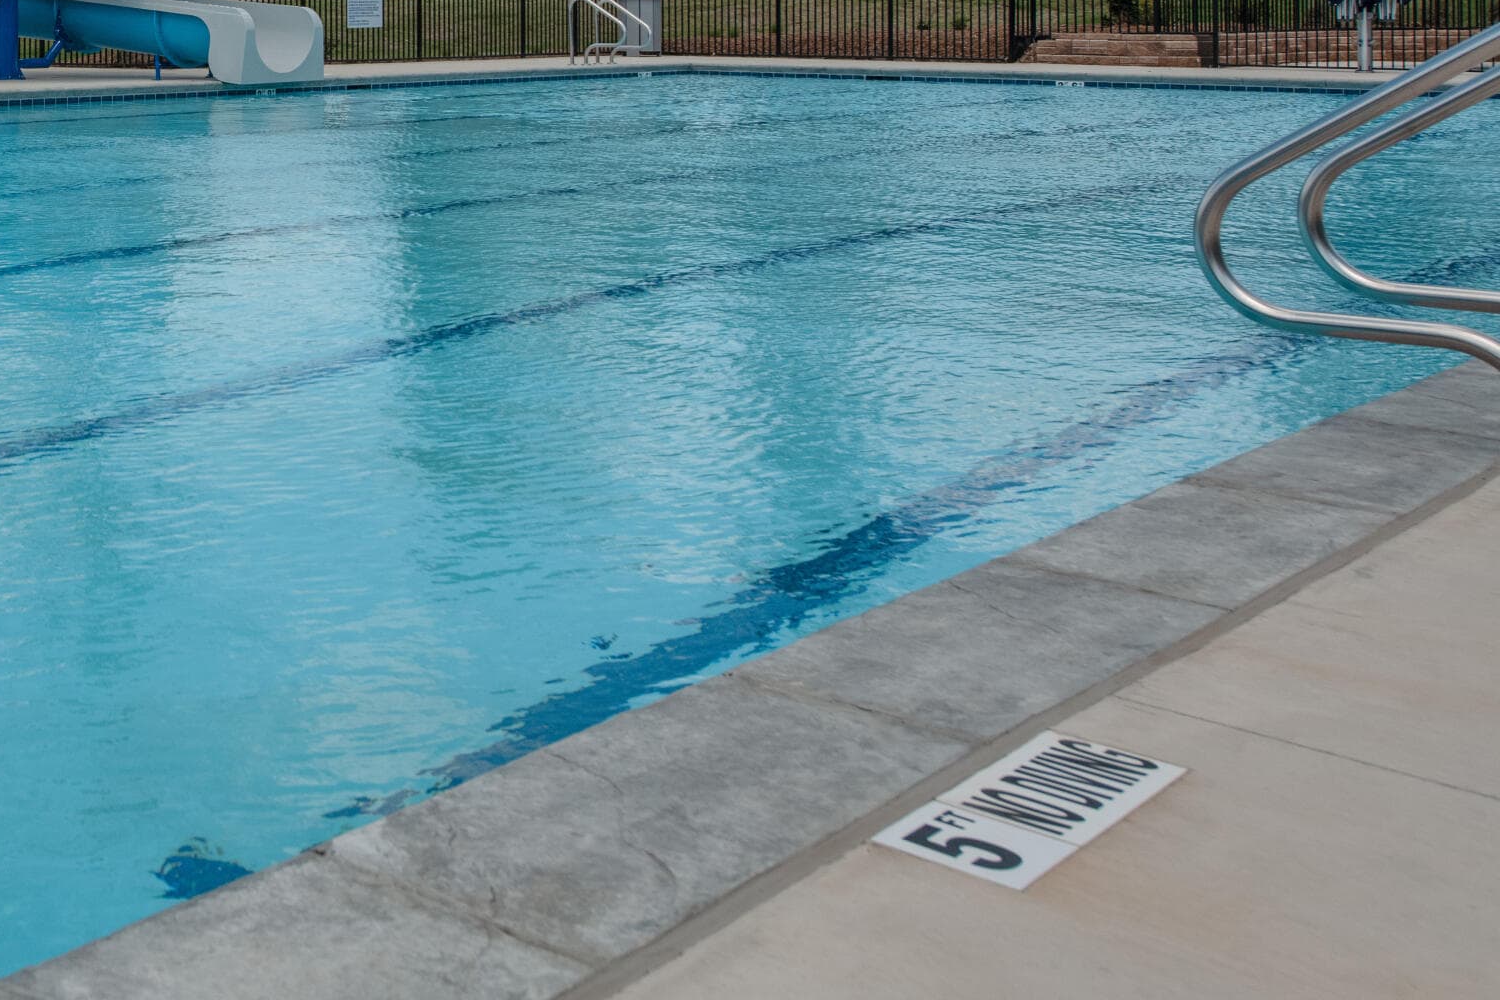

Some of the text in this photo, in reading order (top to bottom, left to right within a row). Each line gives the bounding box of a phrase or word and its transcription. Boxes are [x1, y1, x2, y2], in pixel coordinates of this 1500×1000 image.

[902, 739, 1160, 871] 5 FT NO DIVING
